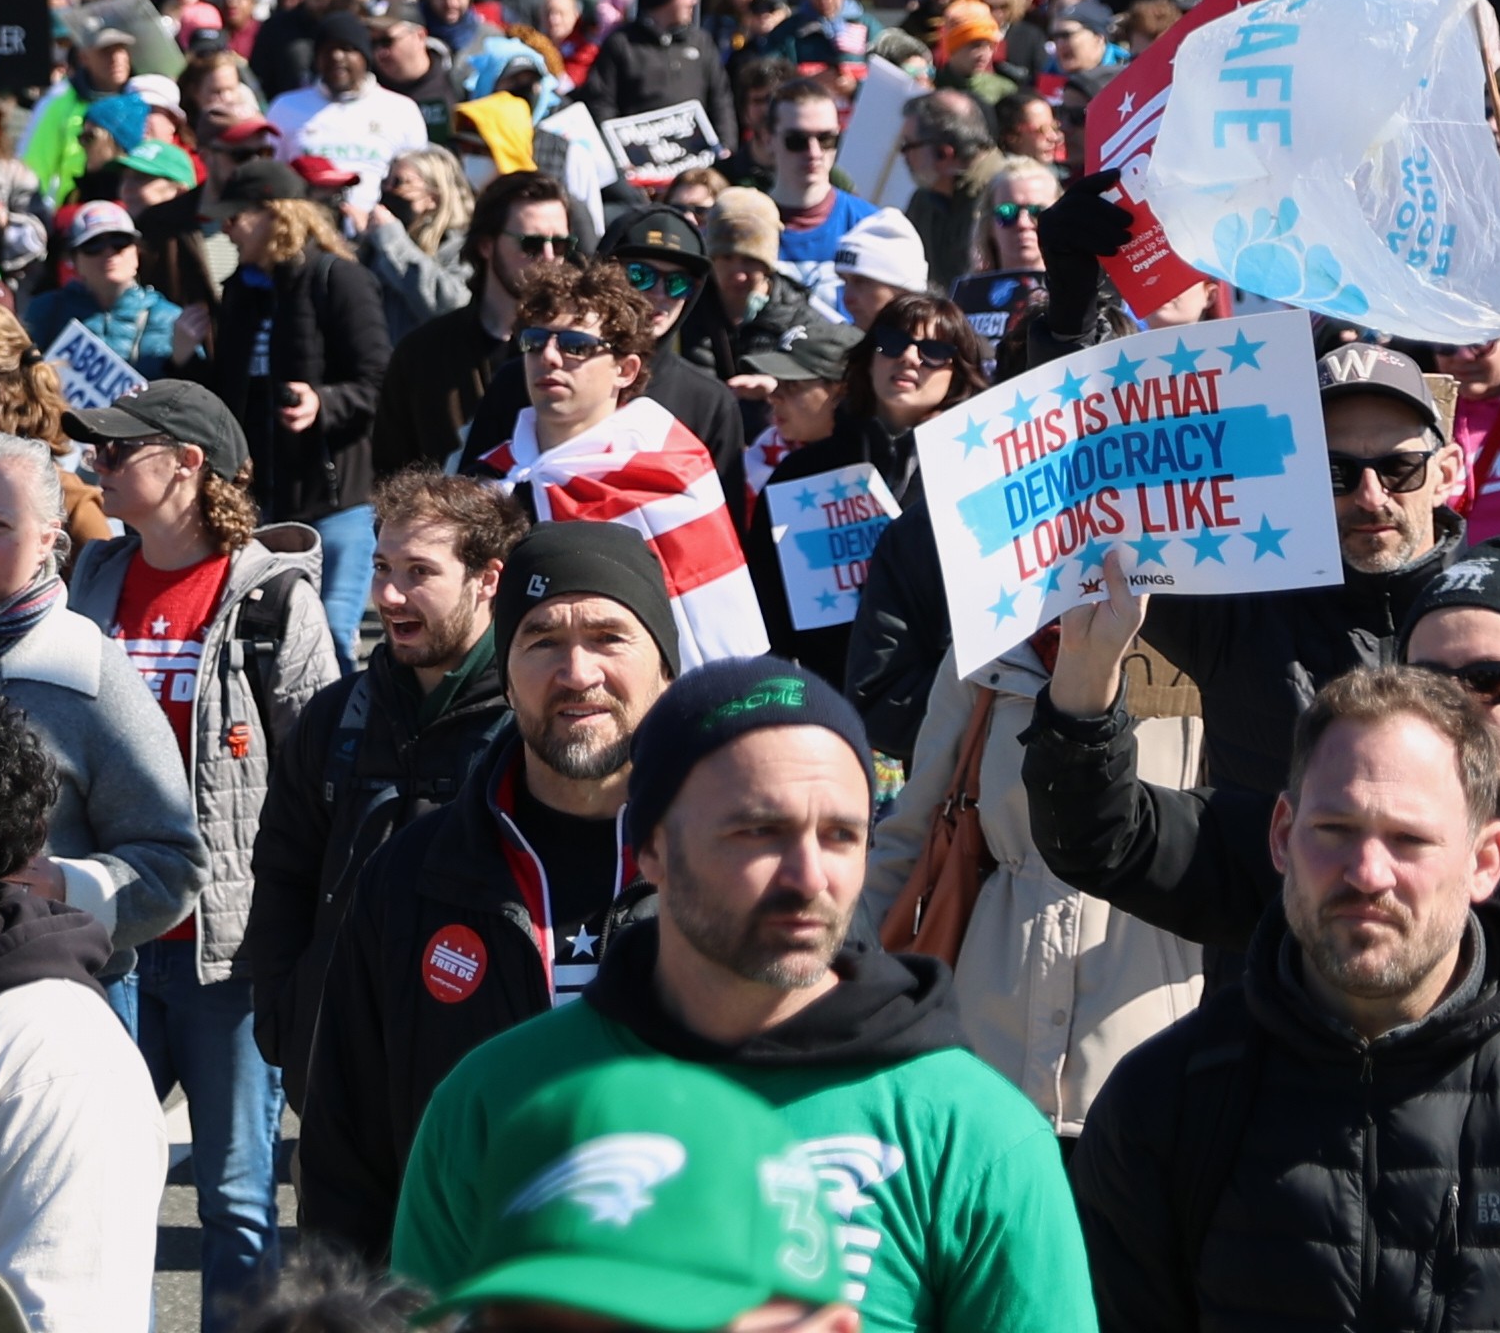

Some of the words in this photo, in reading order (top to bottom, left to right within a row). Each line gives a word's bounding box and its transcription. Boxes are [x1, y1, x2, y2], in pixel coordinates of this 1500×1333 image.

[1126, 248, 1143, 264] Take
[1132, 248, 1169, 273] Organize.
[57, 334, 135, 401] ABOLIS
[1328, 349, 1379, 382] W
[993, 402, 1068, 477] THIS
[1073, 392, 1108, 438] IS
[1111, 367, 1225, 427] WHAT
[1004, 420, 1227, 530] DEMOCRACY
[821, 497, 867, 529] THIS
[1012, 486, 1126, 583] LOOKS
[1137, 474, 1241, 536] LIKE
[1130, 574, 1176, 587] KINGS
[429, 955, 460, 977] FREE
[457, 966, 474, 982] DC
